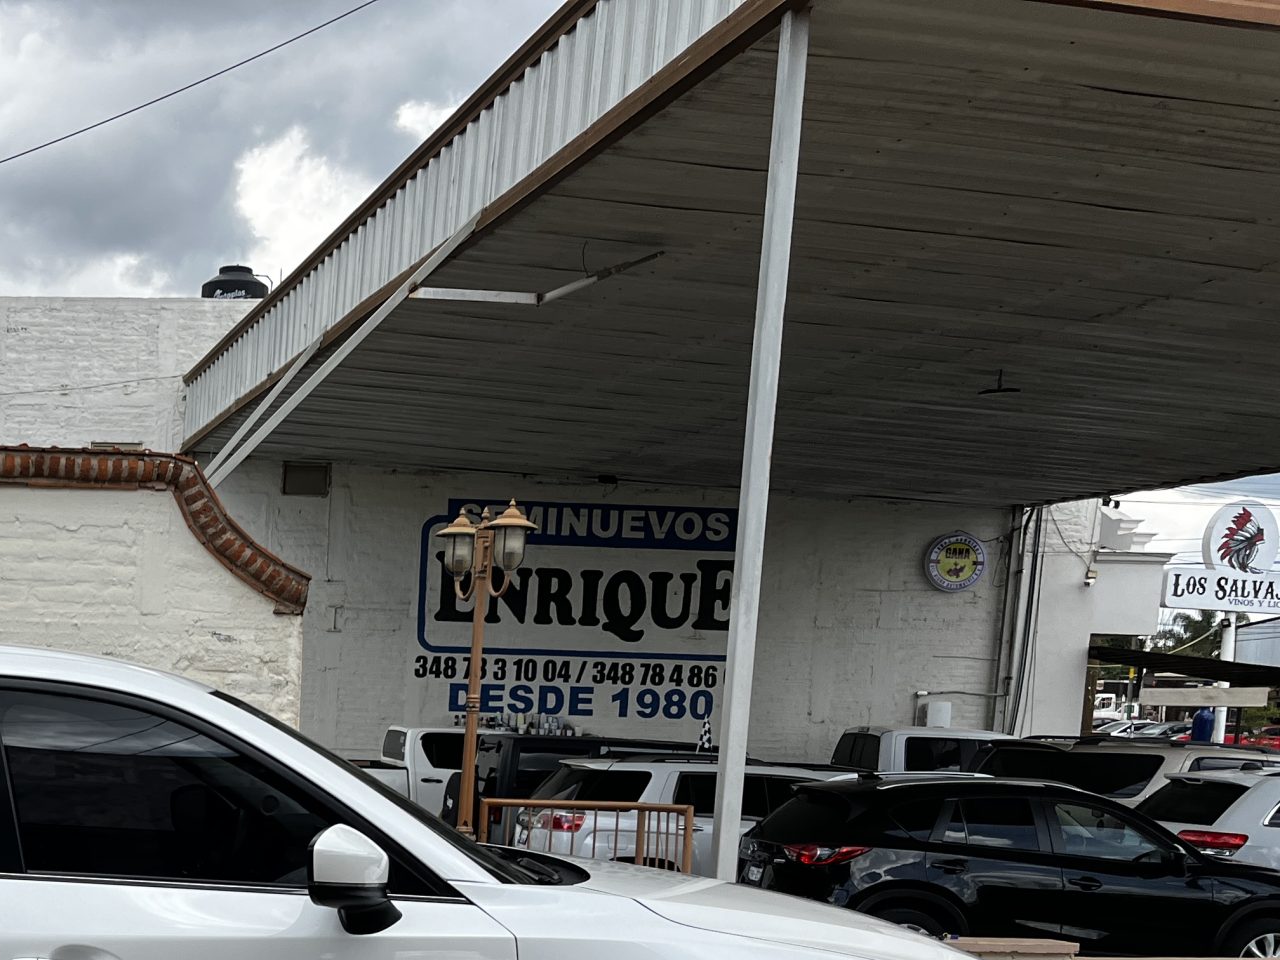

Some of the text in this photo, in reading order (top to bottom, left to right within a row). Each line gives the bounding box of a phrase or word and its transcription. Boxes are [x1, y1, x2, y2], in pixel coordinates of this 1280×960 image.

[1172, 573, 1208, 598] LOS
[1227, 598, 1255, 607] VINOS
[415, 655, 457, 679] 348
[493, 658, 507, 681] 3
[513, 659, 538, 682] 10
[542, 660, 571, 683] 04
[592, 662, 635, 685] 348
[640, 664, 665, 686] 78
[670, 664, 684, 687] 4
[687, 665, 718, 689] 86
[448, 683, 714, 720] DESDE 1980
